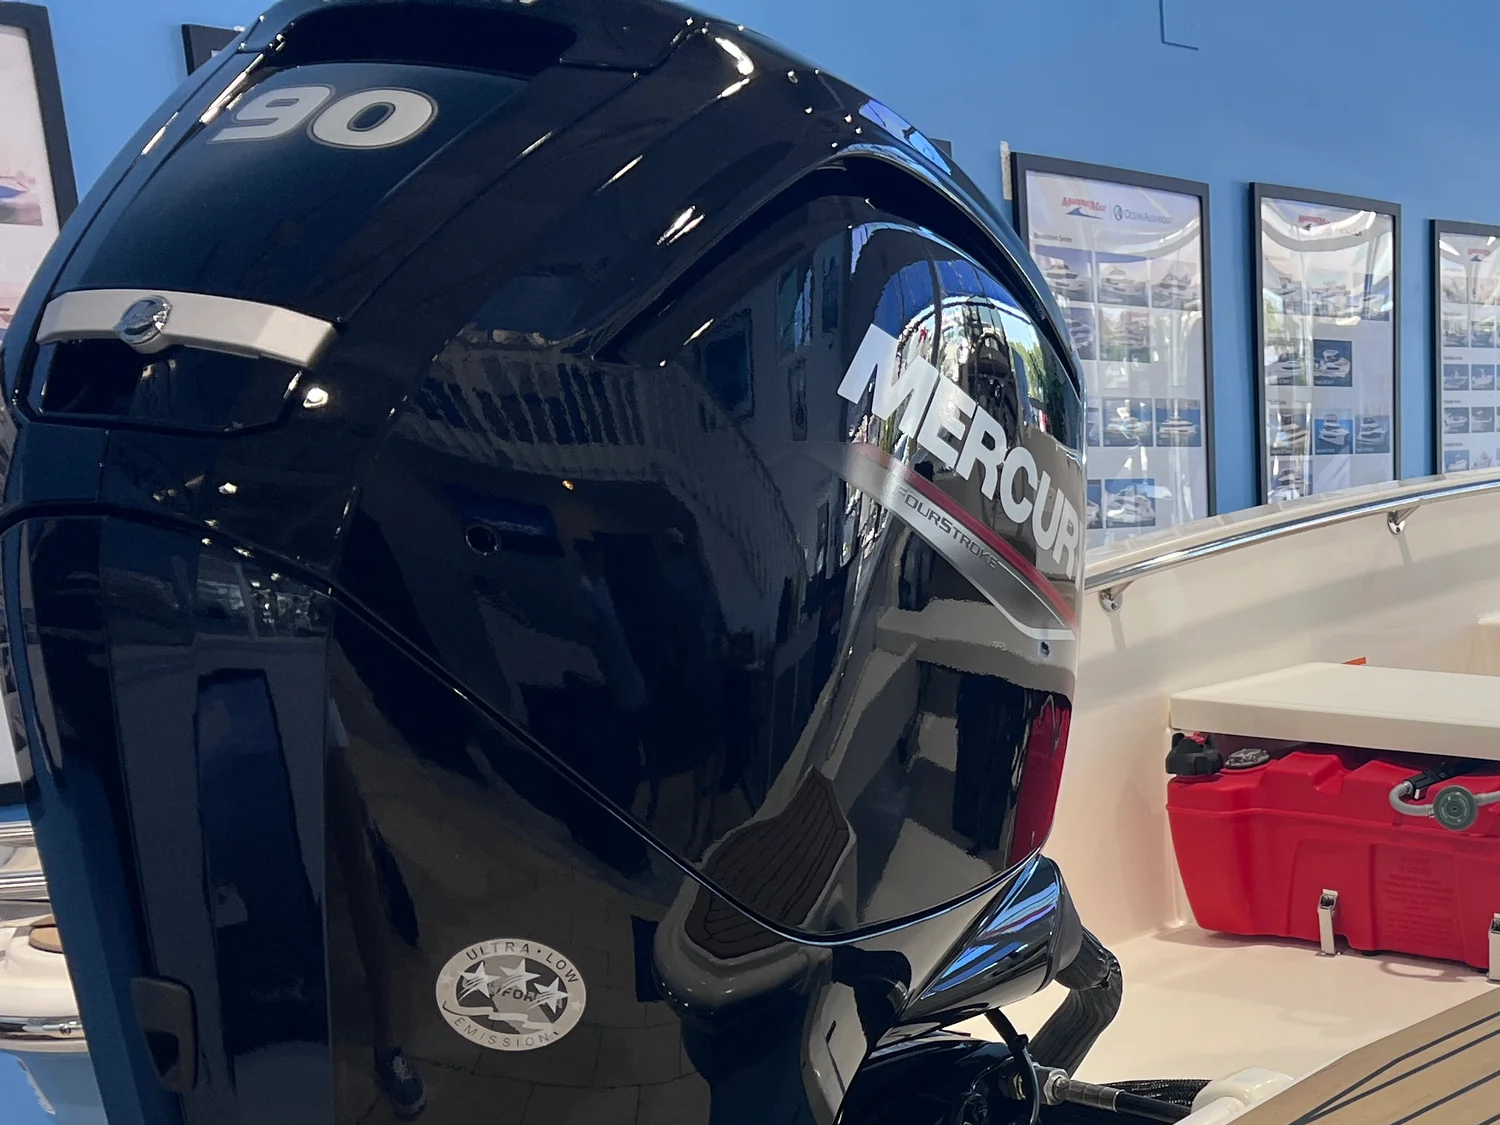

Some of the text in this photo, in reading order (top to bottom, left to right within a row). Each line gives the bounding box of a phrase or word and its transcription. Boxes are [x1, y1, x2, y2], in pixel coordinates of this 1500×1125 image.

[207, 84, 439, 150] 90
[837, 323, 1084, 590] MERCUR
[892, 484, 998, 569] FOURSTROKE
[466, 941, 579, 984] ULTRA LOW
